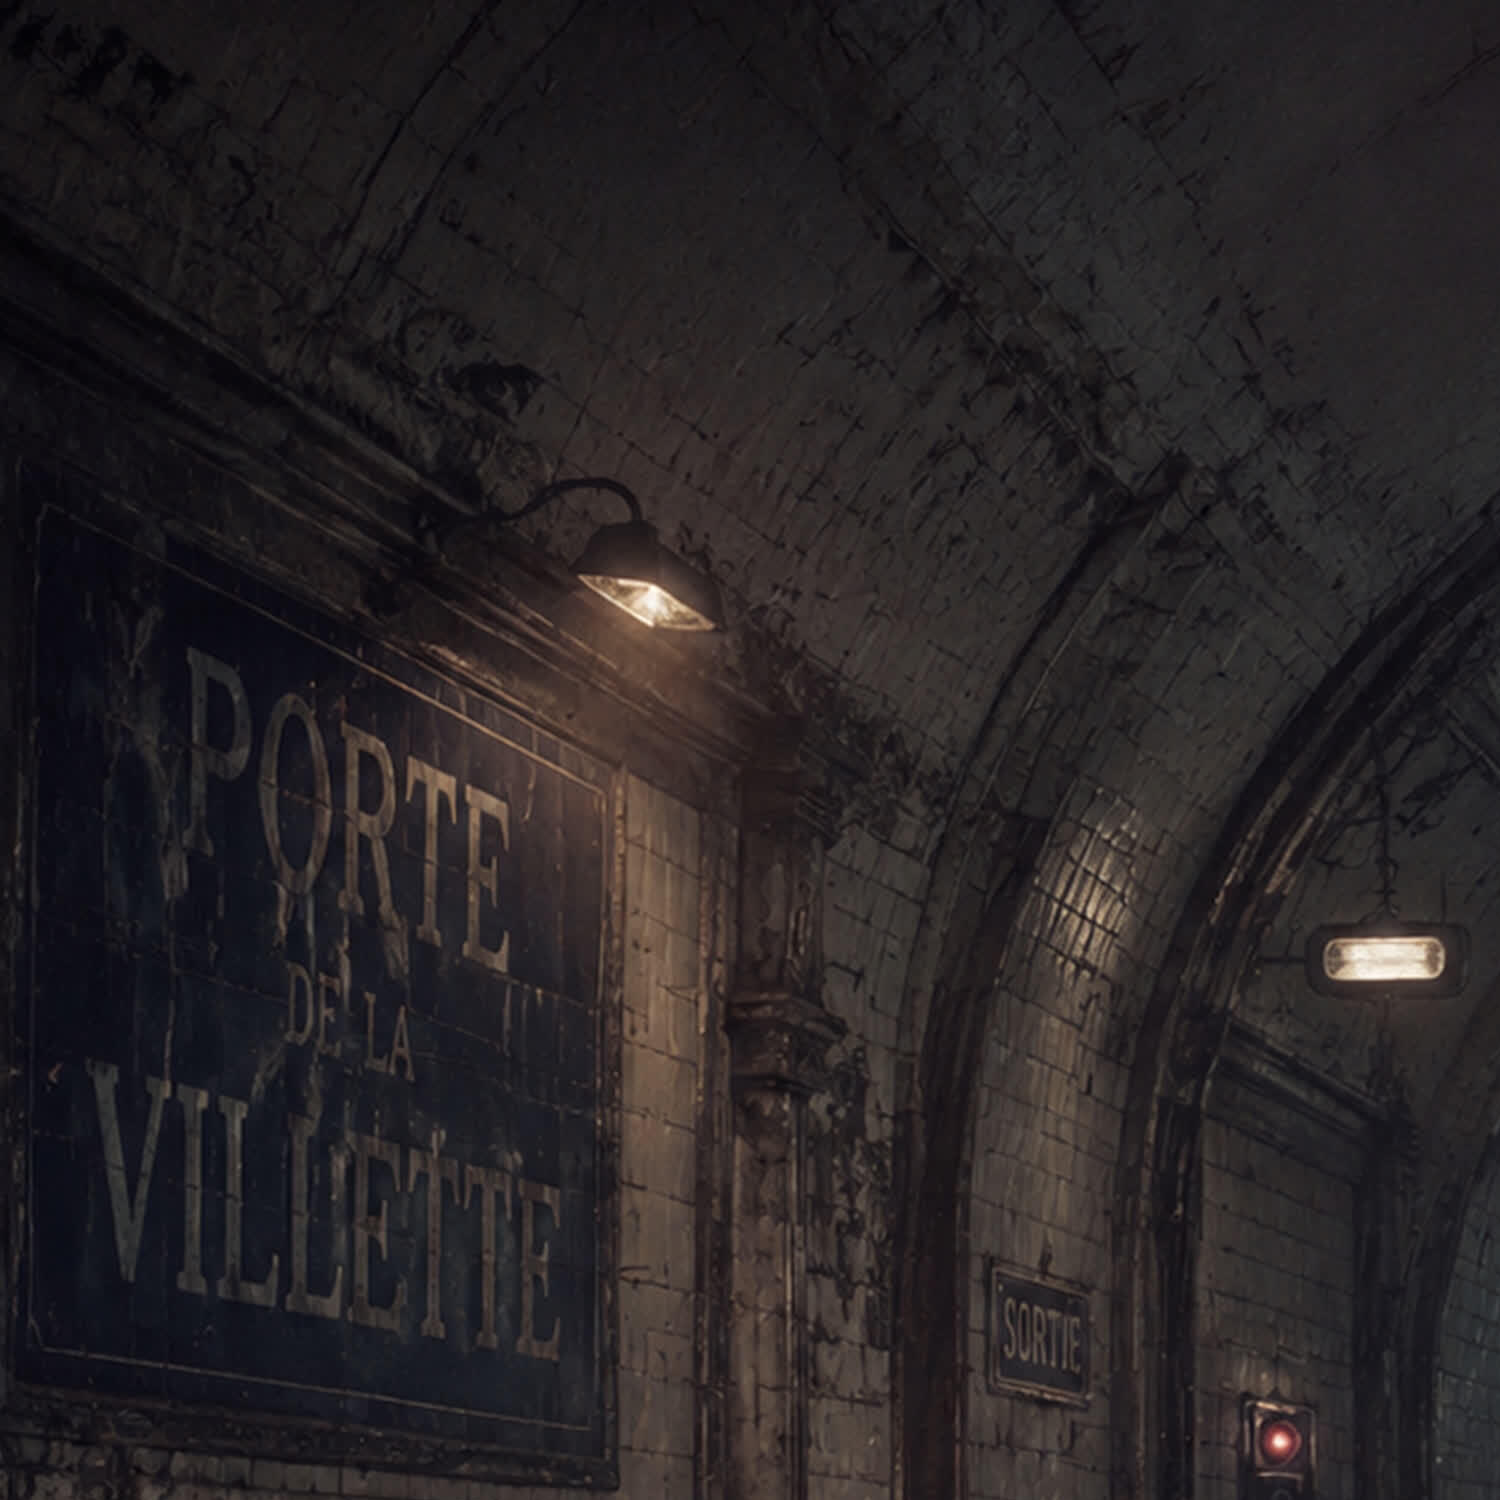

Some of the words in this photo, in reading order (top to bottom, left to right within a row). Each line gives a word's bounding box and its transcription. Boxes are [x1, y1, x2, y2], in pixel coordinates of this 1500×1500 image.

[185, 646, 511, 971] PORTE
[285, 962, 342, 1058] DE
[363, 992, 416, 1082] LA
[87, 1061, 562, 1361] VILLETTE
[1003, 1297, 1082, 1374] SORTIE
